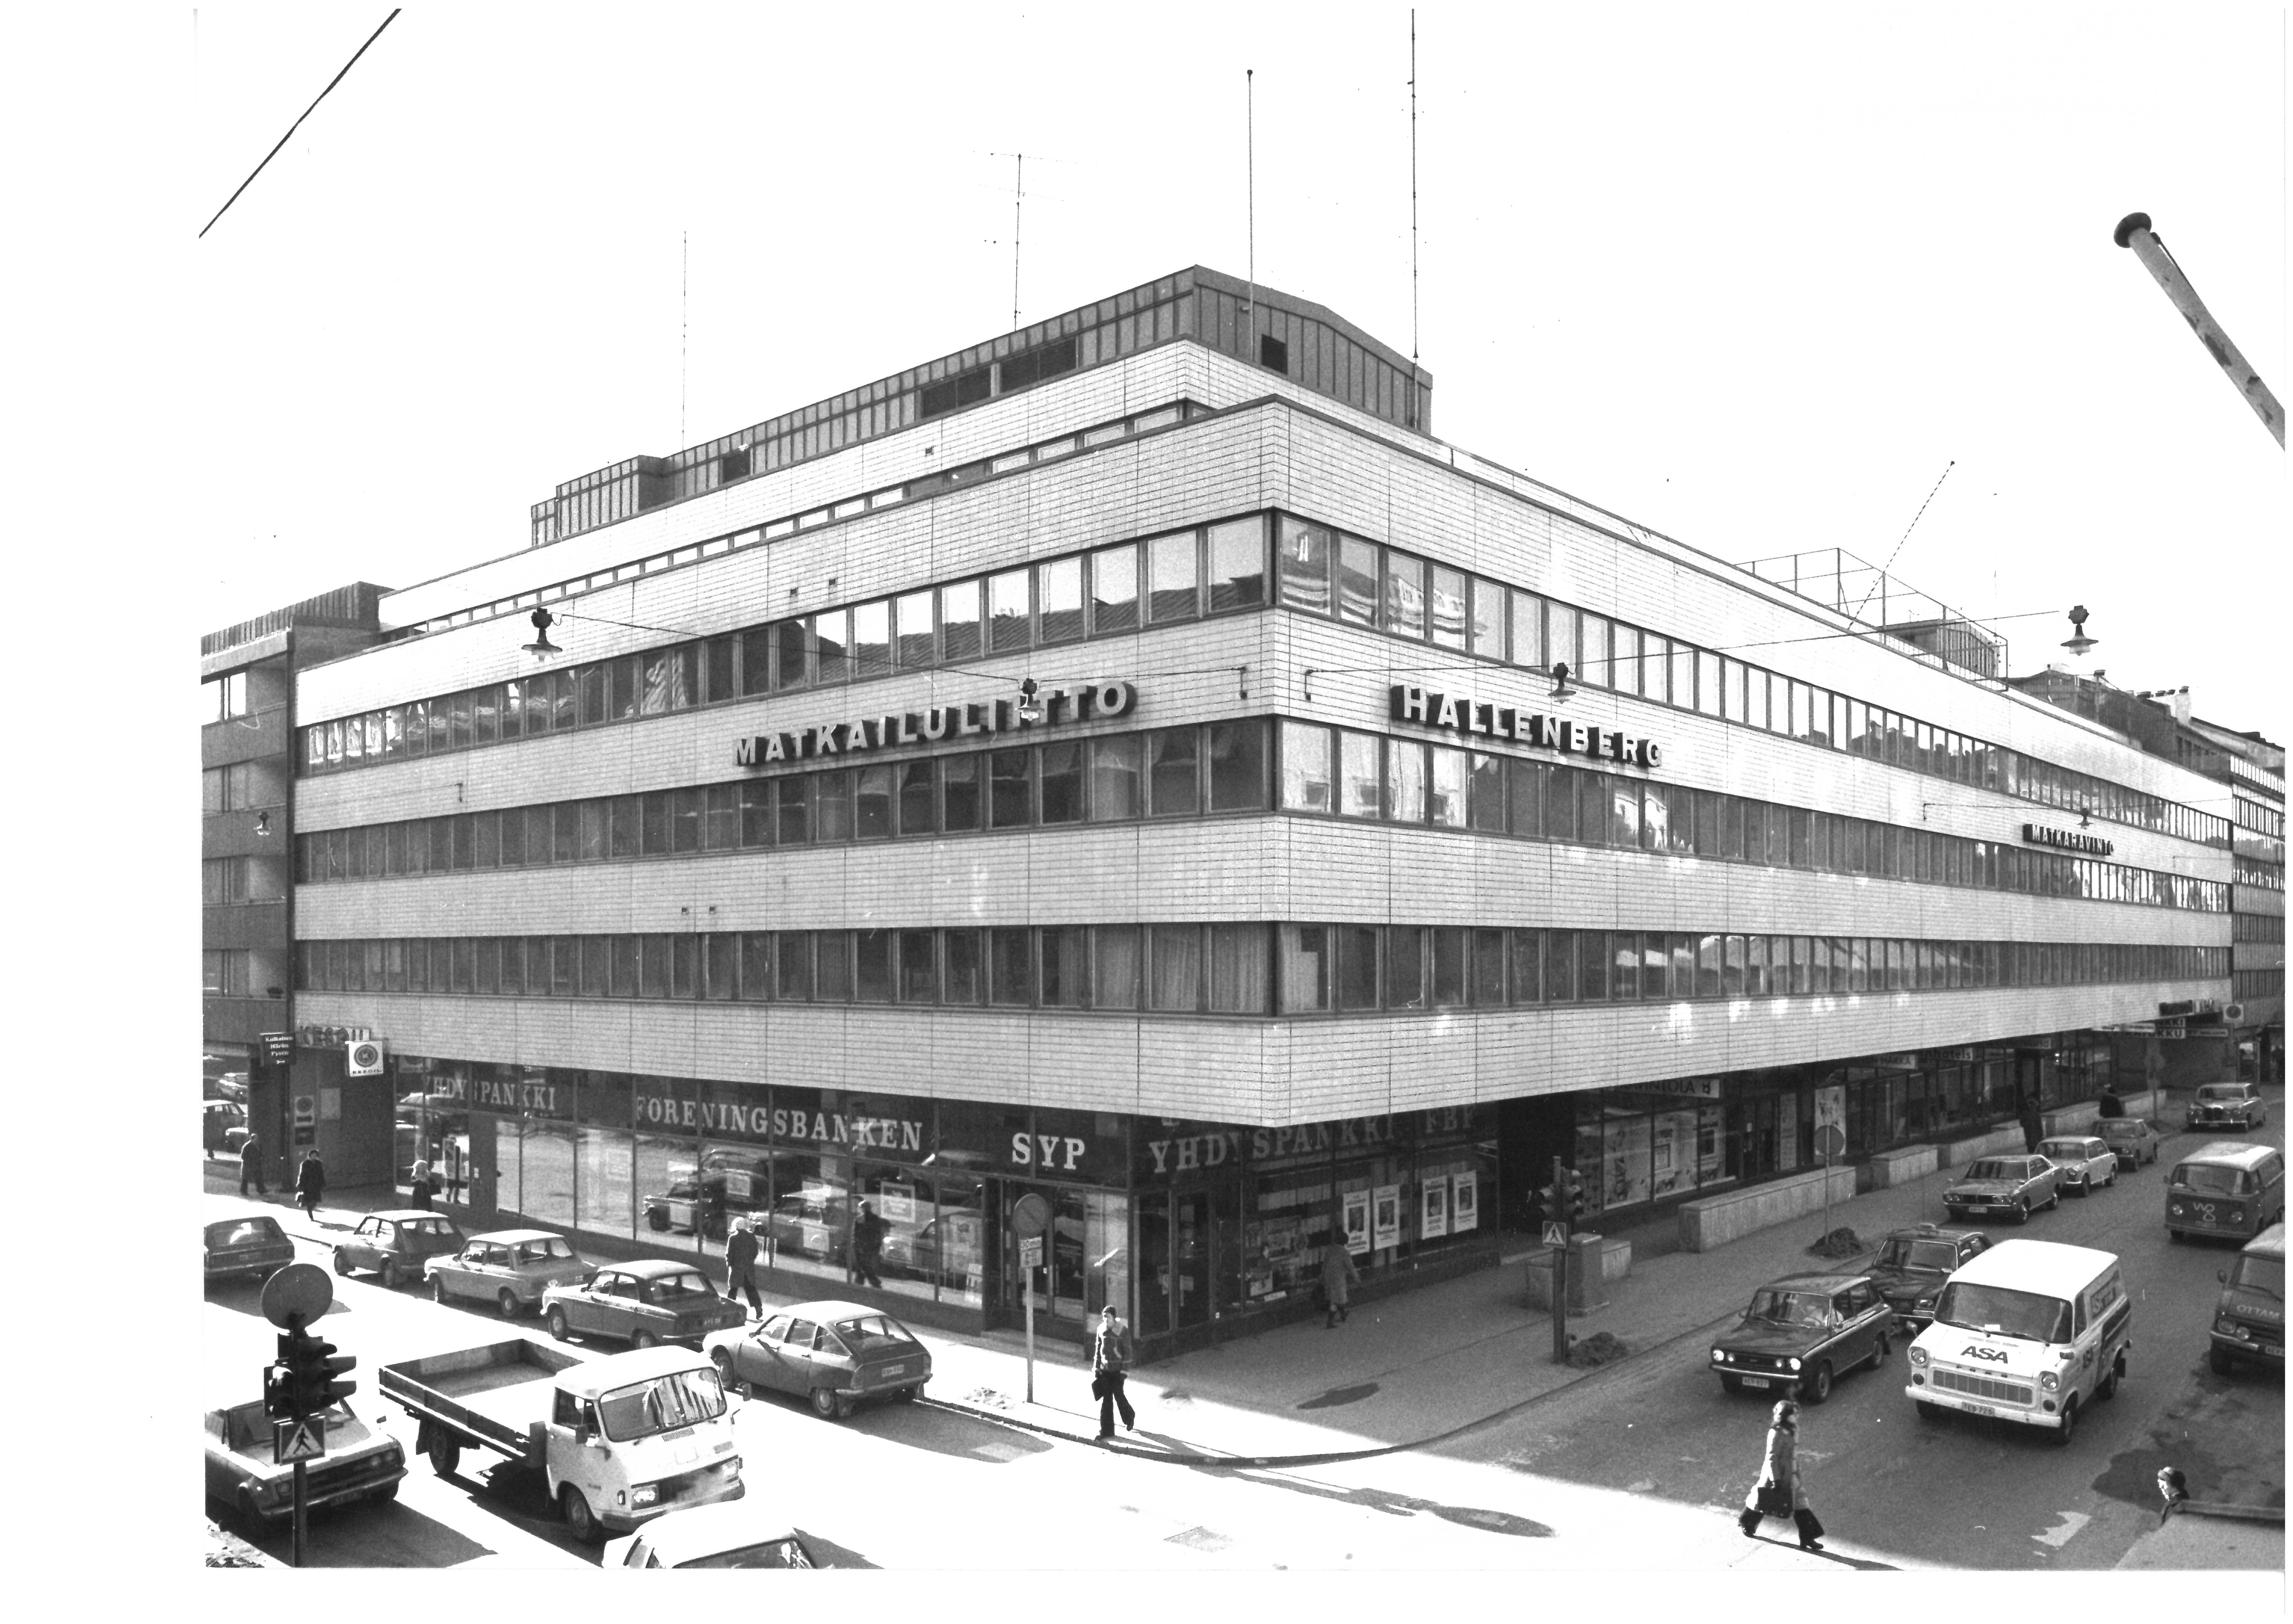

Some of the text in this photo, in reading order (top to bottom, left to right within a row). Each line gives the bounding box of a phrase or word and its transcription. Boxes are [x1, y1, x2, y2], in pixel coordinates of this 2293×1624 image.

[734, 680, 1133, 767] MATKAILULIITTO
[1394, 685, 1663, 768] HALLENBERG
[637, 1096, 923, 1151] FÖRENINGSBANKEN
[1011, 1132, 1085, 1170] SYP
[1961, 1346, 2008, 1364] ASA
